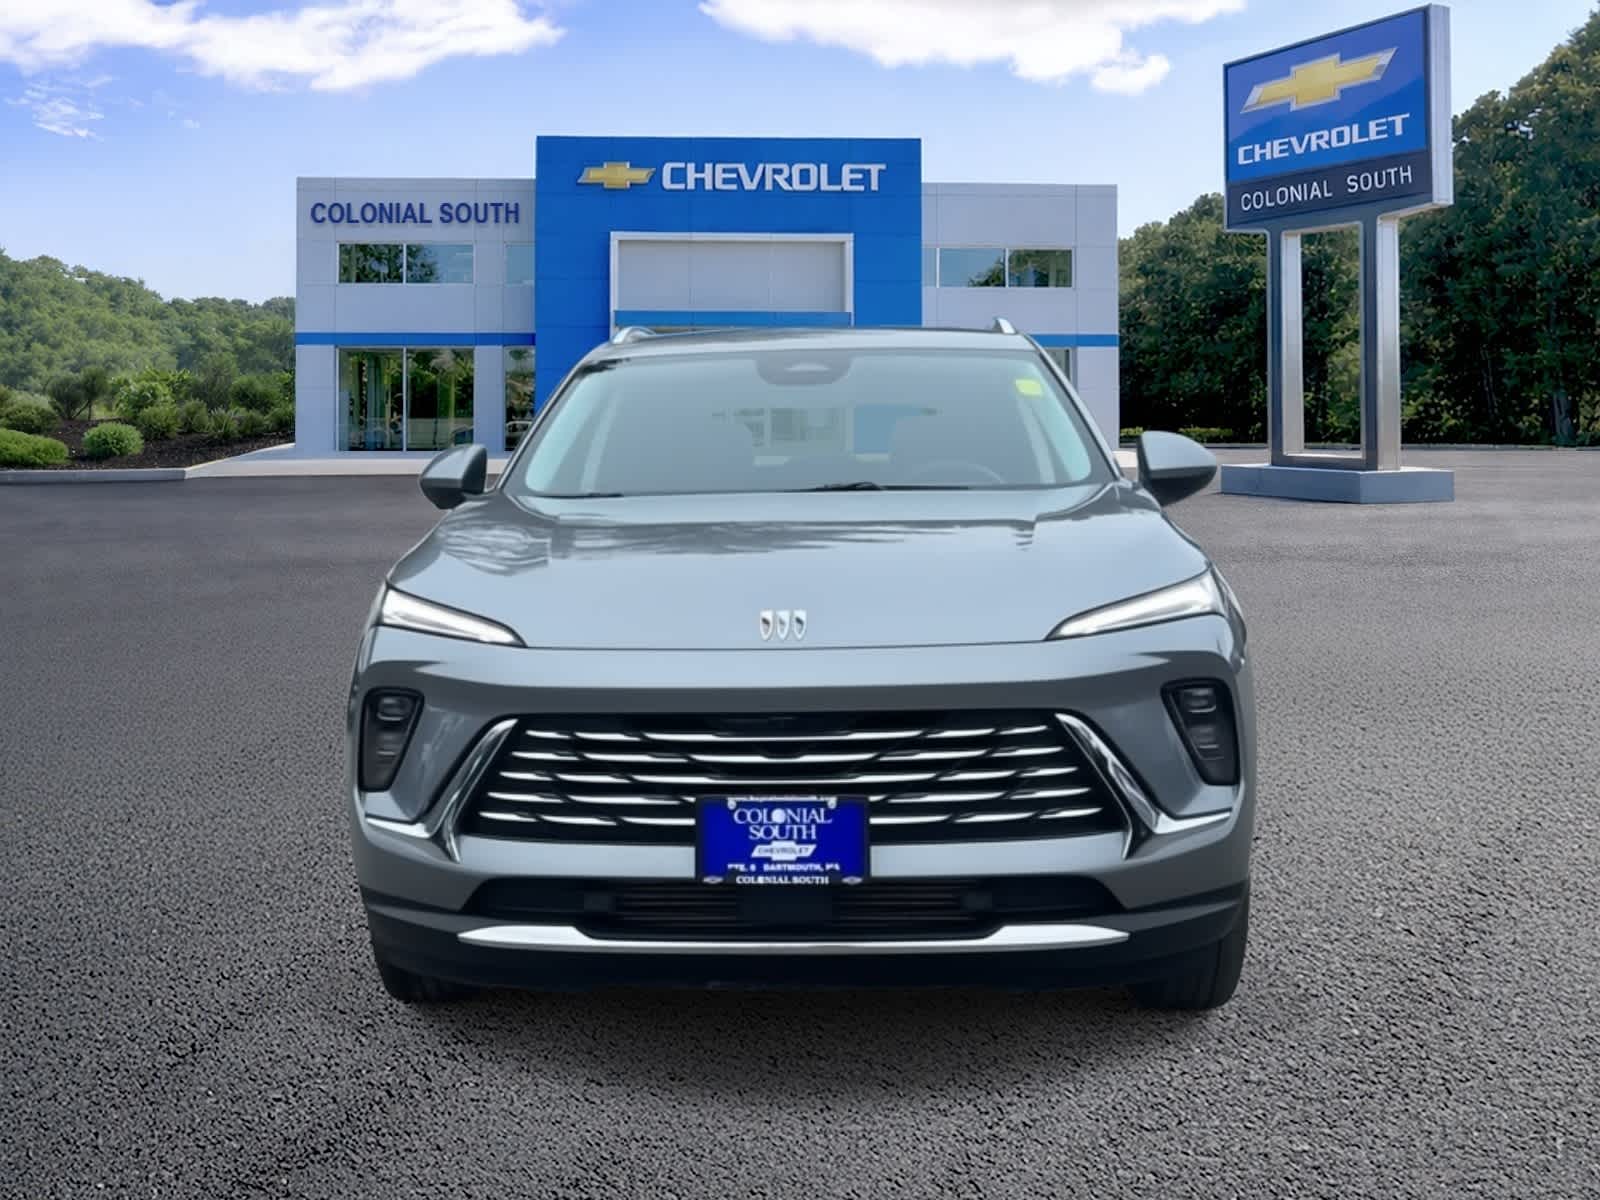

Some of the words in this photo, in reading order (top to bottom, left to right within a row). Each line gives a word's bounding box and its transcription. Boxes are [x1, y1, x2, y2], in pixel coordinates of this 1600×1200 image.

[1237, 112, 1411, 165] CHEVROLET
[661, 161, 888, 192] CHEVROLET
[1240, 180, 1333, 212] COLONIAL
[1346, 165, 1413, 194] SOUTH
[310, 202, 433, 225] COLONIAL
[439, 202, 520, 225] SOUTH
[733, 807, 833, 825] COLONIAL
[748, 824, 817, 841] SOUTH
[757, 847, 810, 855] CHEVROLET
[735, 875, 791, 884] COLONIAL
[792, 875, 830, 884] SOUTH
